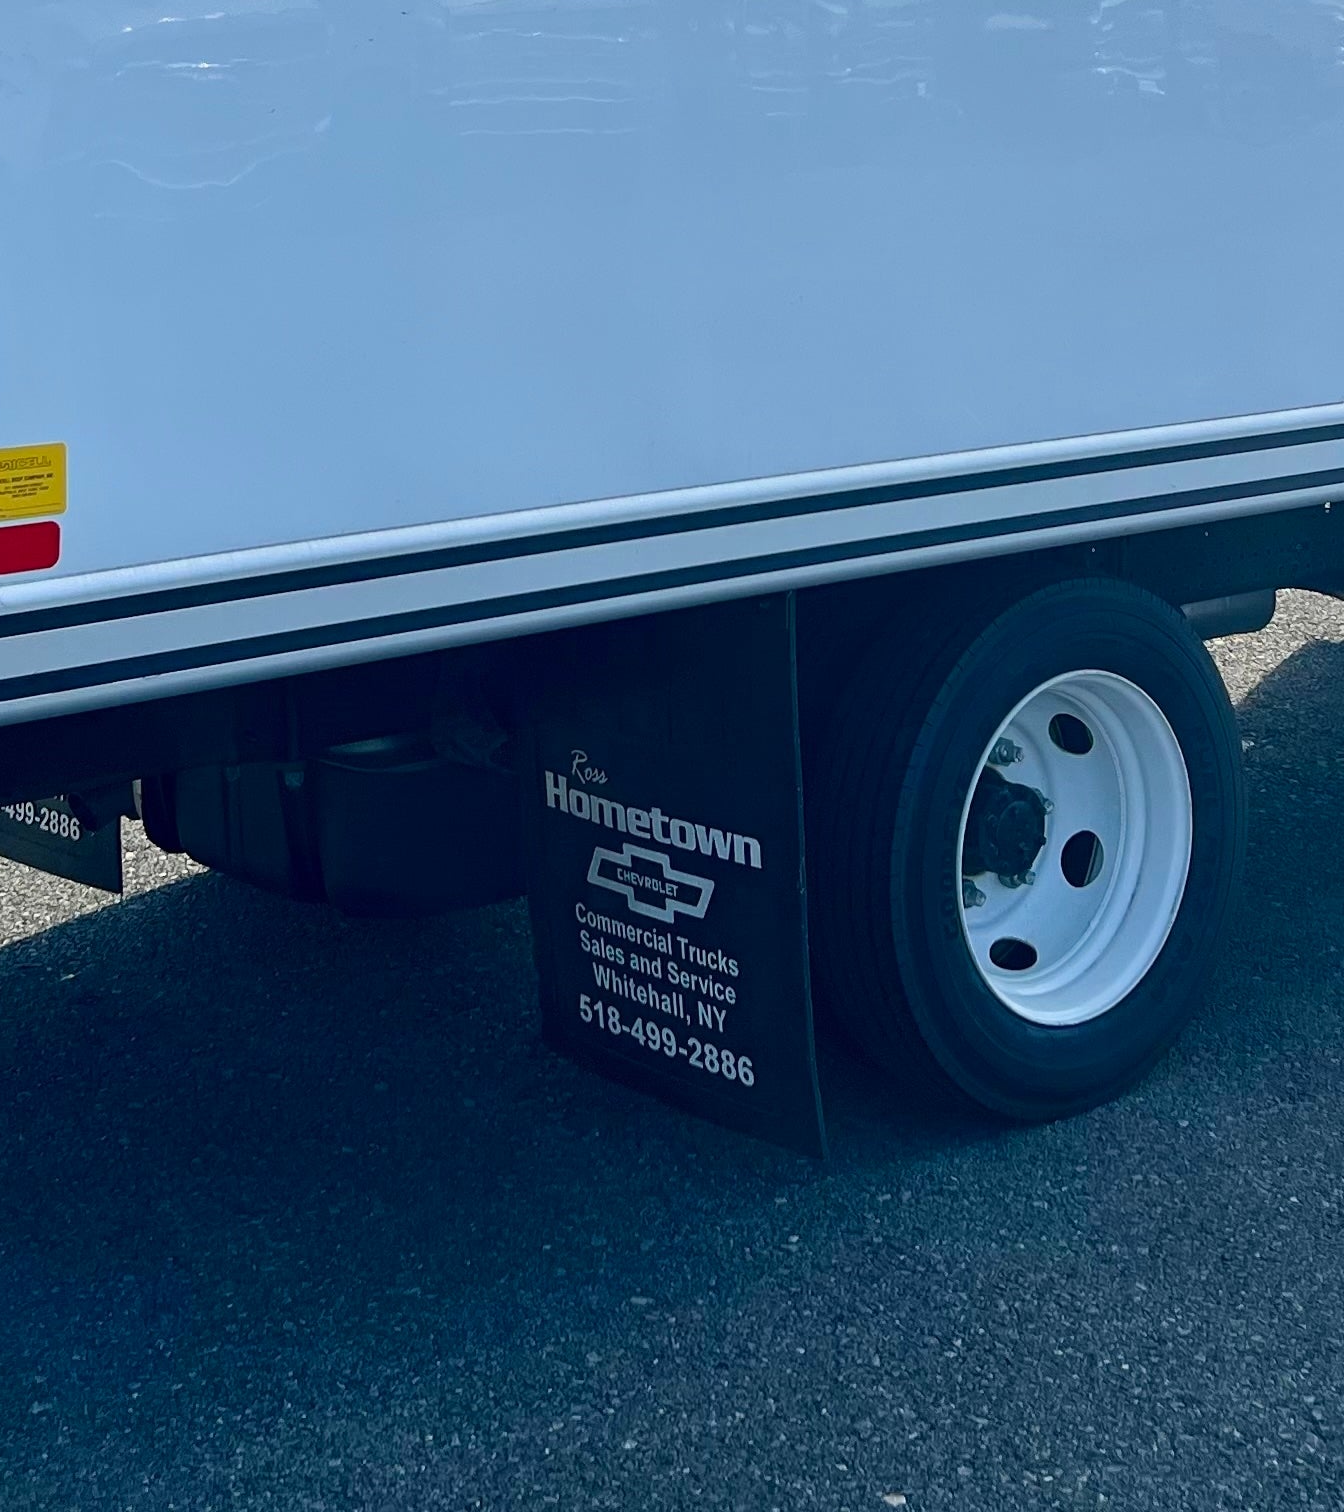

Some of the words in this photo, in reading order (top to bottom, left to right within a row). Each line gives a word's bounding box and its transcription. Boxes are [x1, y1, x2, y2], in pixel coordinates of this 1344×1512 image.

[571, 749, 608, 784] Ross
[545, 770, 762, 869] Hometown
[617, 868, 679, 897] CHEVROLET
[575, 902, 673, 956] Commercial
[676, 936, 739, 978] Trucks
[580, 930, 625, 965] Sales
[630, 953, 662, 979] and
[667, 961, 737, 1005] Service
[592, 962, 691, 1026] Whitehall,
[698, 1000, 727, 1033] NY
[579, 993, 755, 1087] 518-499-2886
